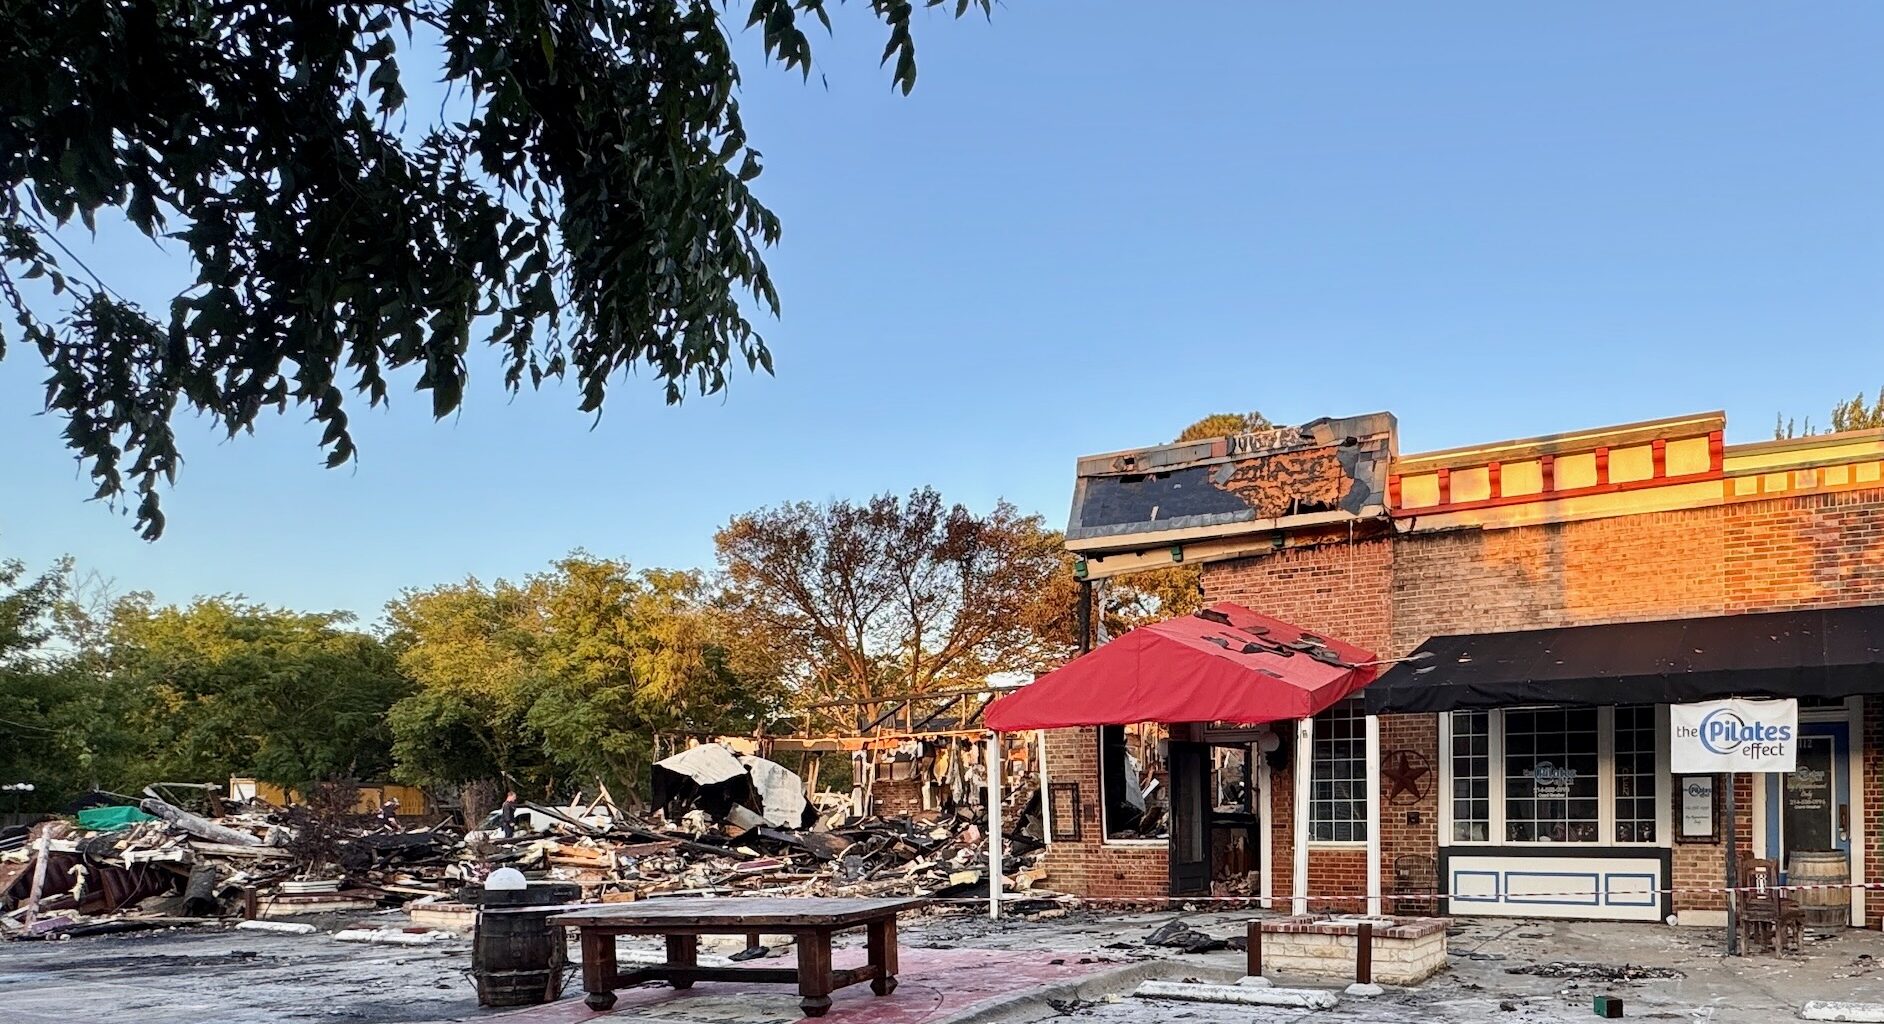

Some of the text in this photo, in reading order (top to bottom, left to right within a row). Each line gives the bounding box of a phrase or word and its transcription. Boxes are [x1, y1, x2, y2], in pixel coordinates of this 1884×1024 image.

[1677, 720, 1791, 742] the Pilates
[1742, 743, 1785, 760] effect
